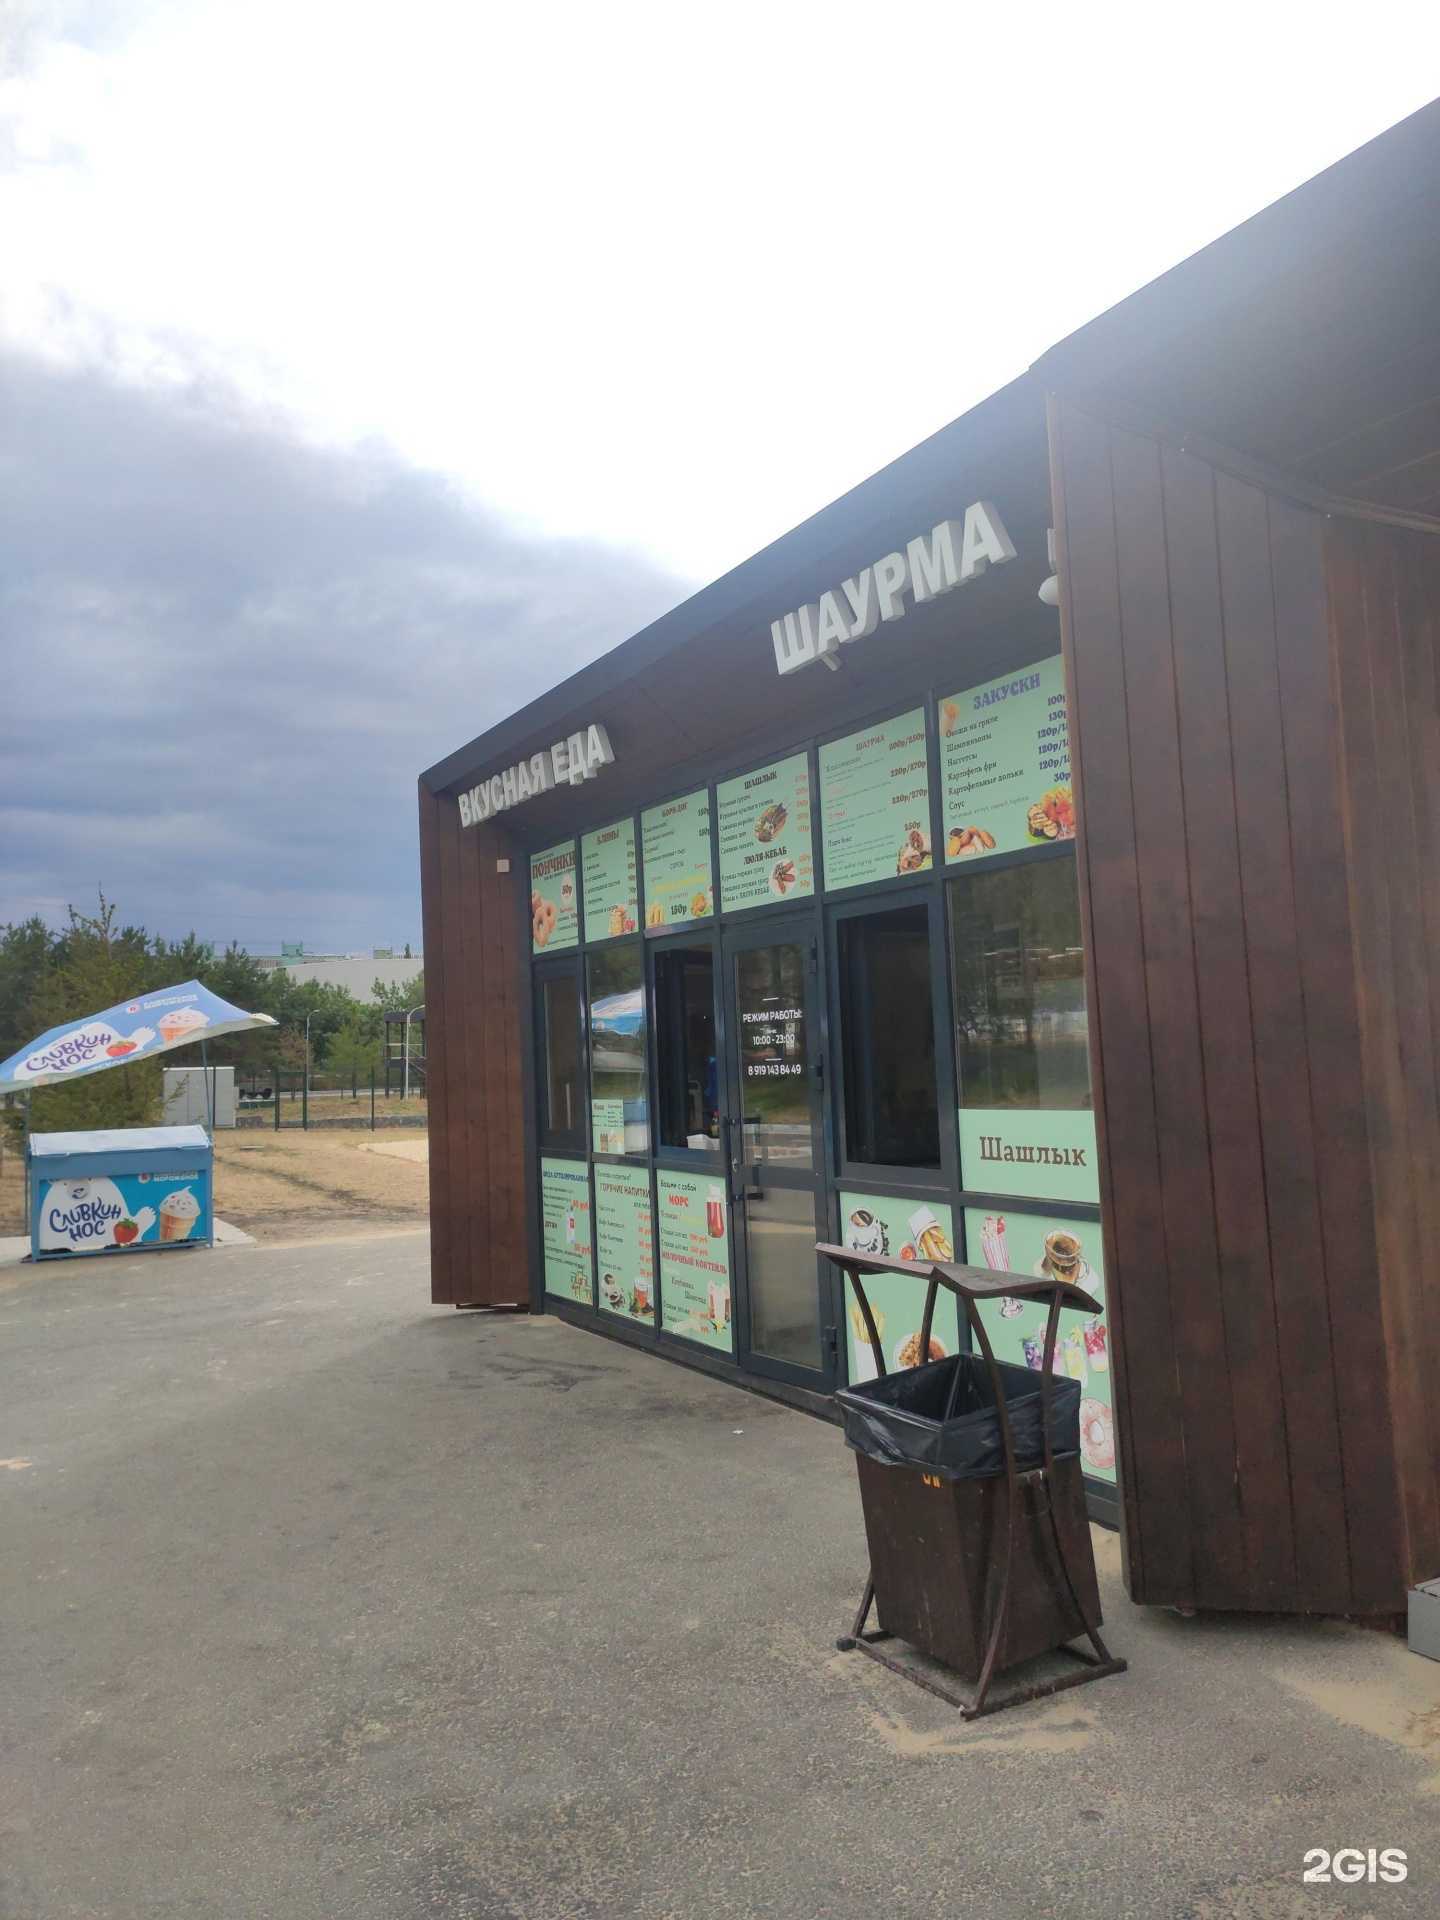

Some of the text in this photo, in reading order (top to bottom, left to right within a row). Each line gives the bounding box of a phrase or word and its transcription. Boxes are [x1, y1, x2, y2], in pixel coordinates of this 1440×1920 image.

[458, 723, 615, 828] ВКУСНАЯ ЕДА
[744, 771, 777, 790] ШАШЛЫК
[743, 1012, 769, 1023] РЕЖИМ
[753, 1034, 771, 1046] 10:00
[51, 1048, 97, 1071] НОС
[748, 1064, 801, 1076] 8 919 143 84 49
[979, 1135, 1087, 1167] Шашлык
[69, 1221, 106, 1242] НОС
